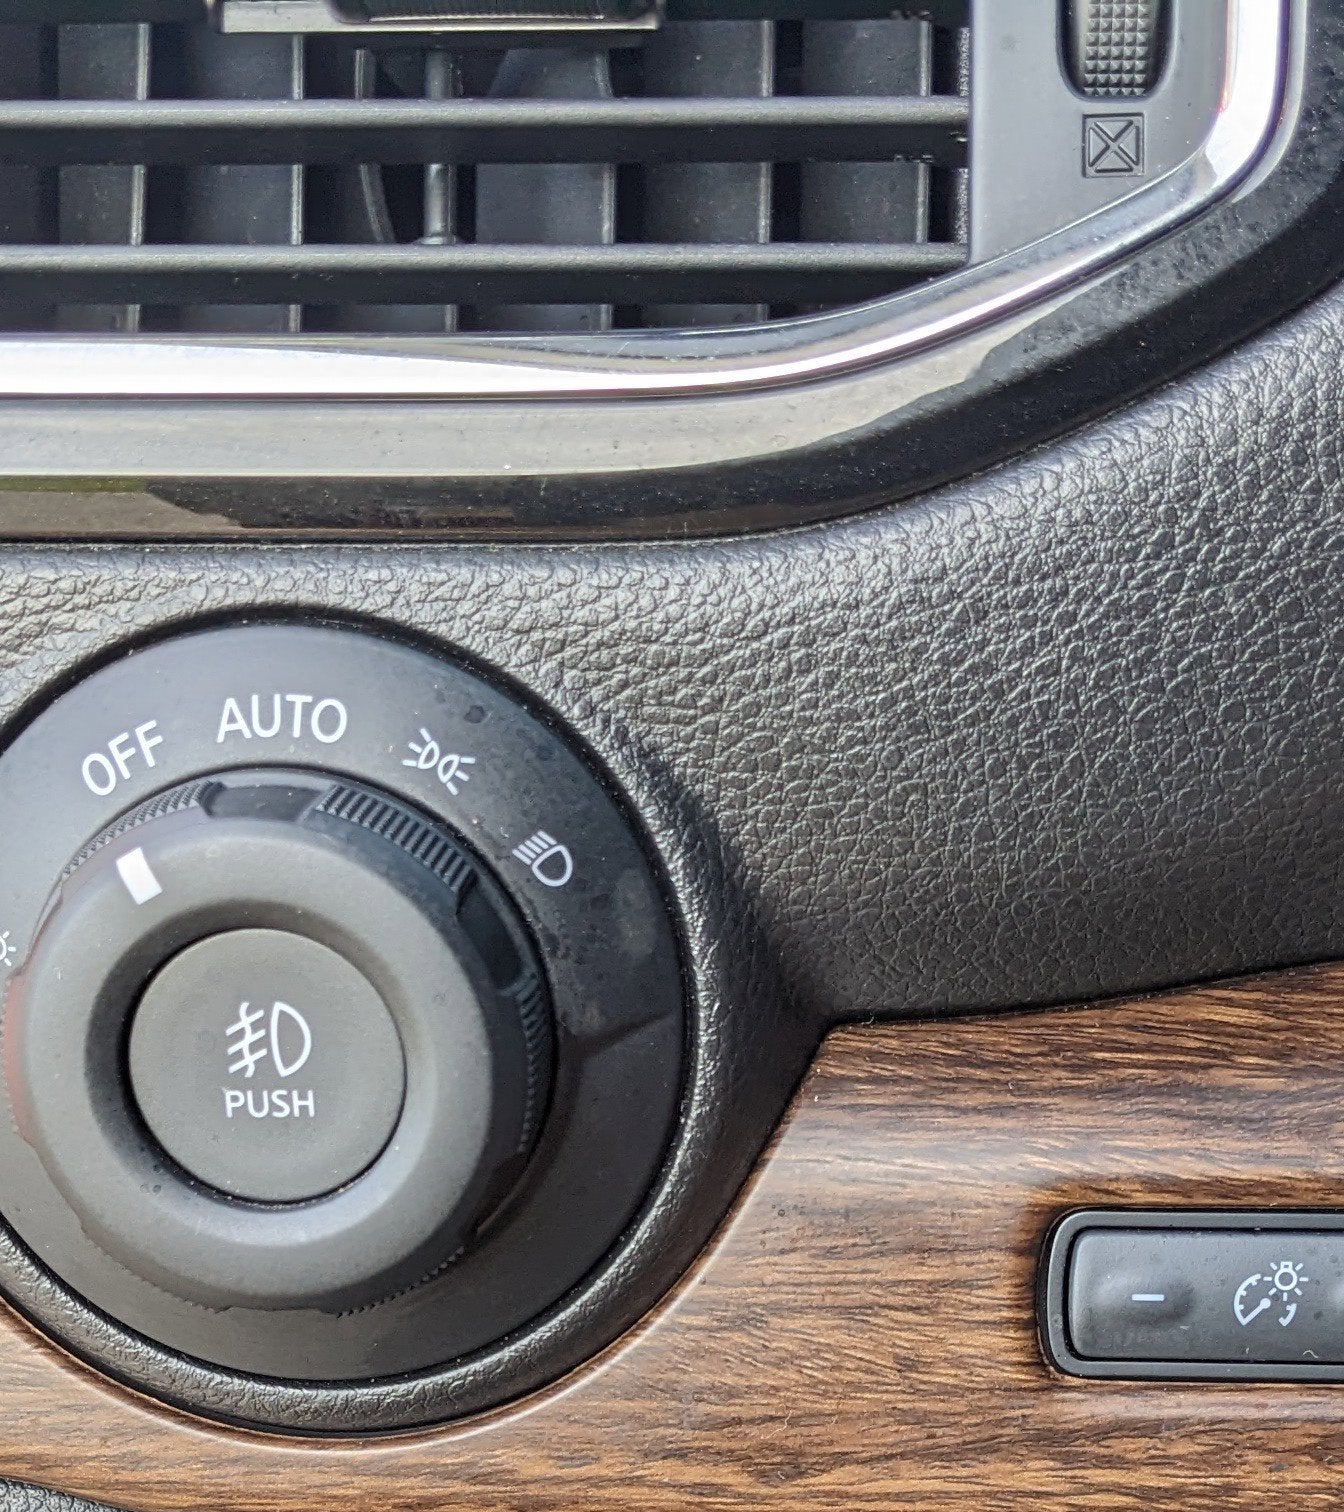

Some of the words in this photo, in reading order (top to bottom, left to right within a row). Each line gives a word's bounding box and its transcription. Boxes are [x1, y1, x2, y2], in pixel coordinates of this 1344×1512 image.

[215, 693, 348, 744] AUTO
[81, 719, 164, 796] OFF
[222, 1088, 315, 1119] PUSH
